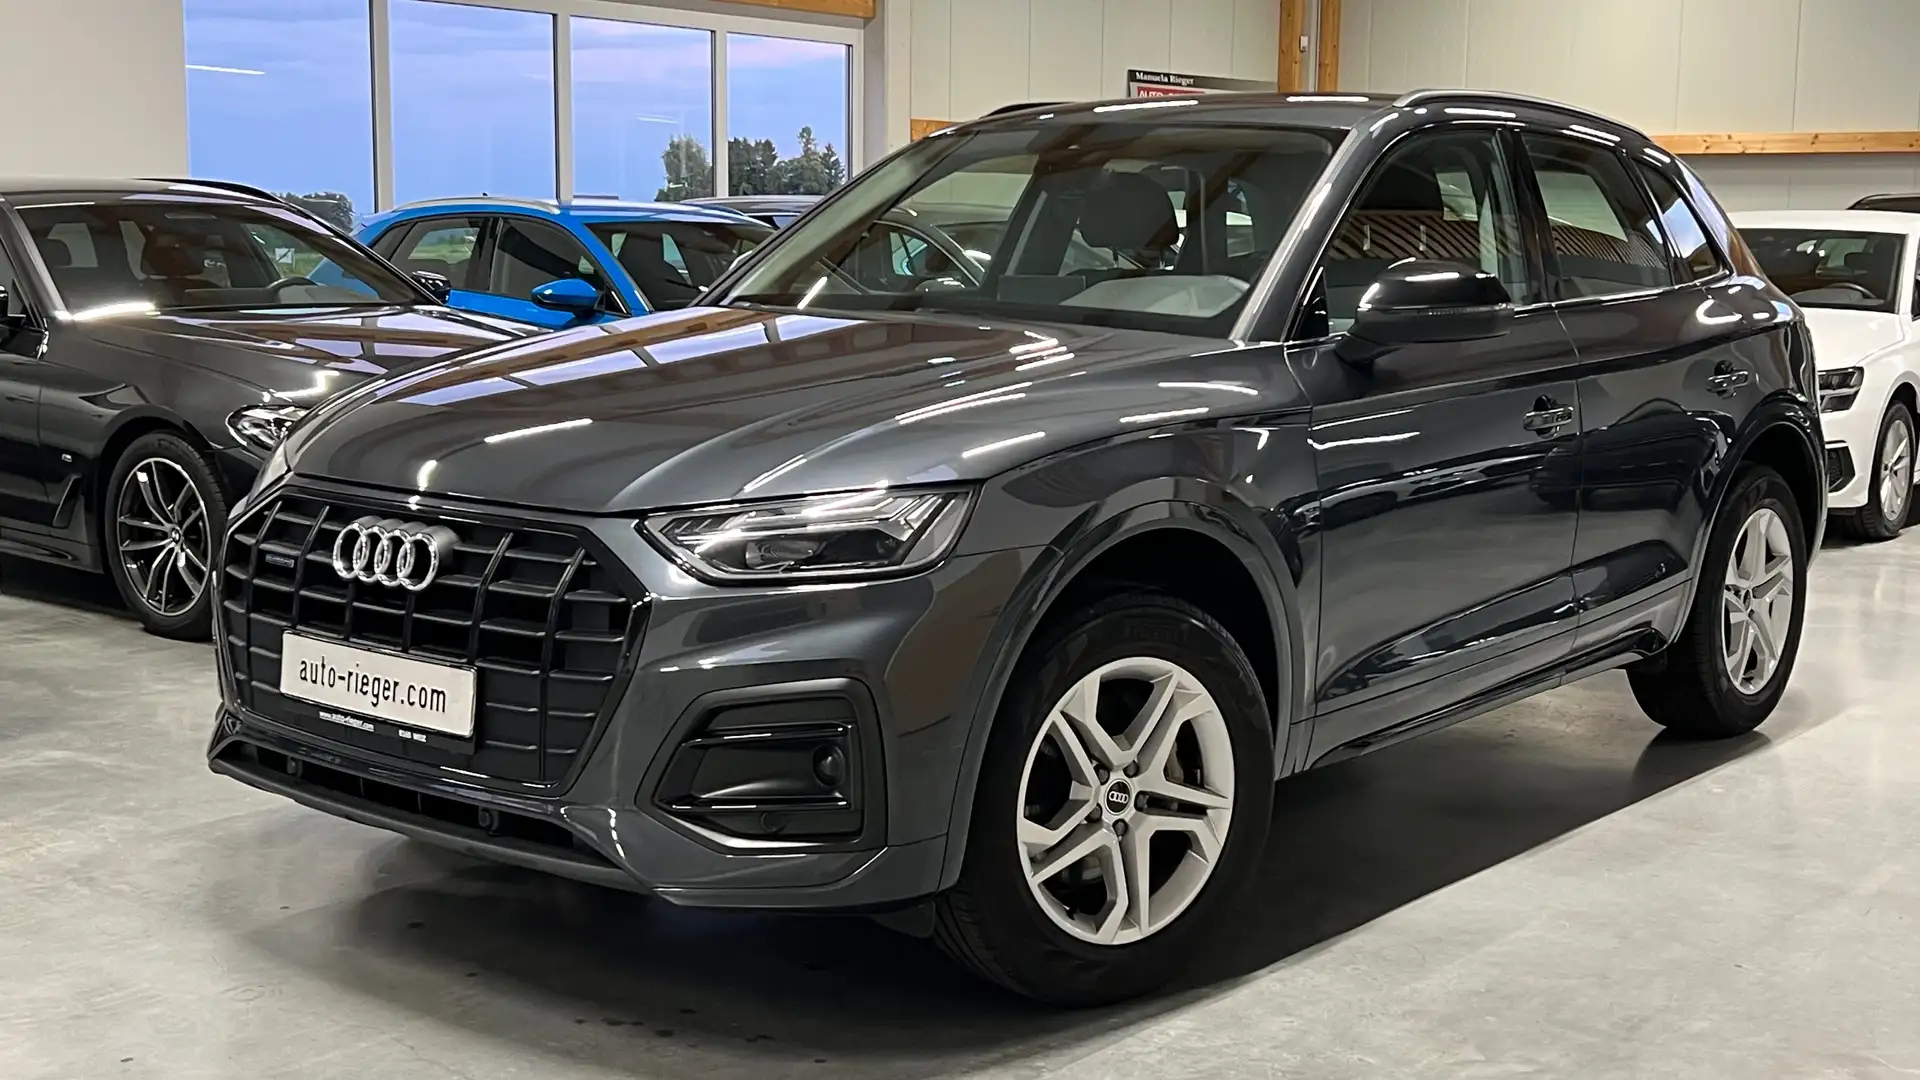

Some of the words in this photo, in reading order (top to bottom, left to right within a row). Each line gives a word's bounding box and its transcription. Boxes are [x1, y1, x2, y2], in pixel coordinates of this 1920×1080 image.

[1136, 72, 1168, 83] Manuela
[1169, 75, 1194, 86] Rieger
[300, 656, 446, 713] auto-rieger.com
